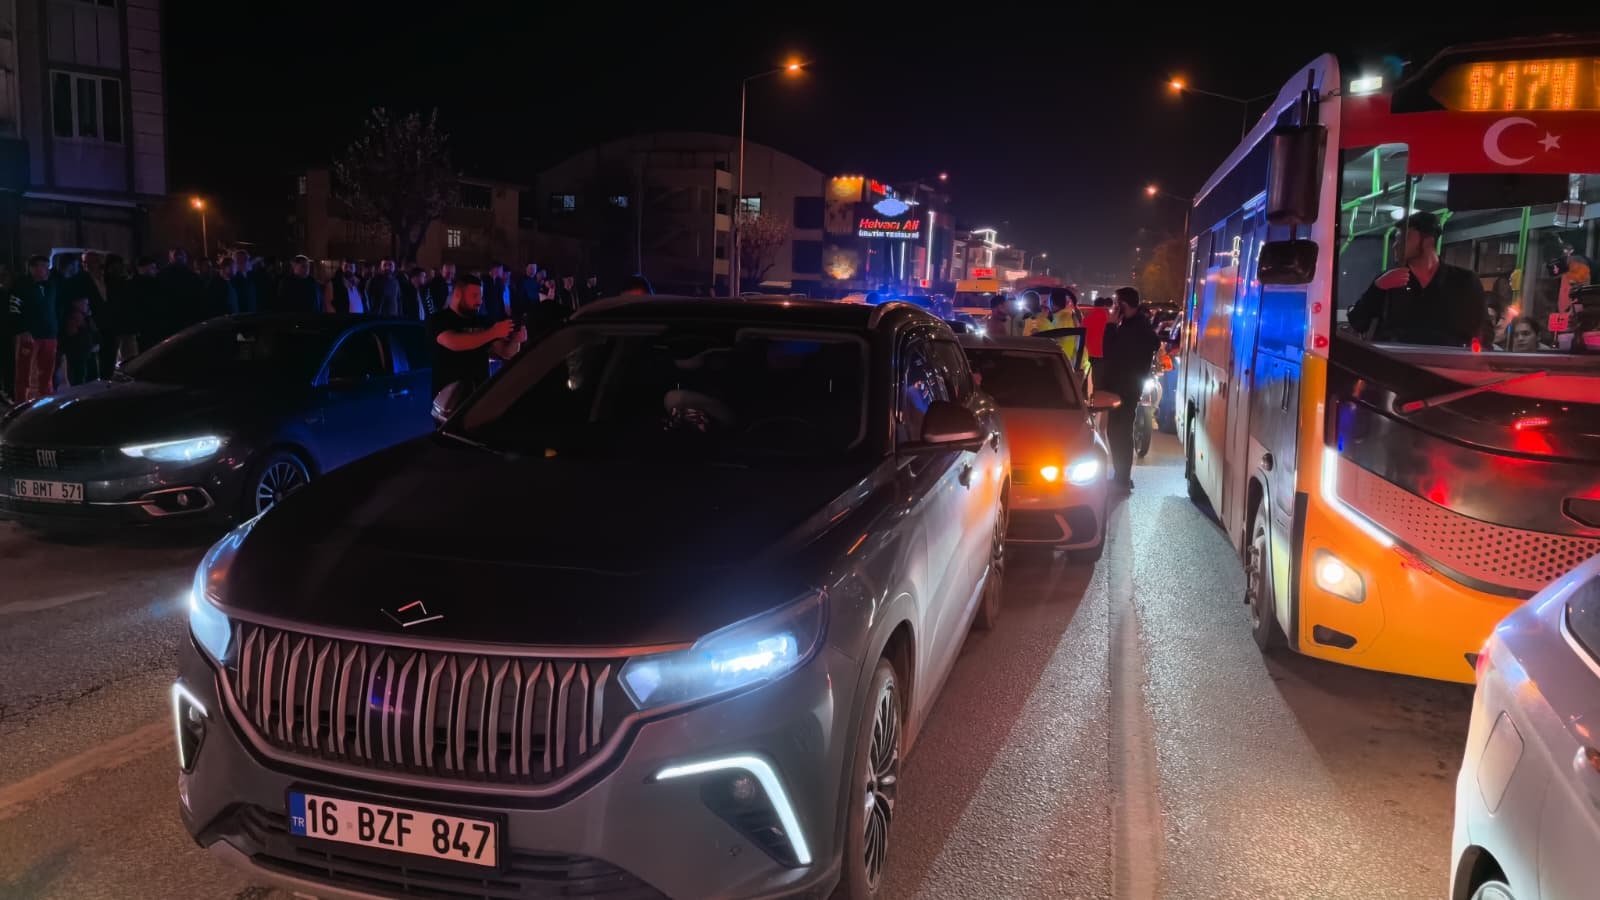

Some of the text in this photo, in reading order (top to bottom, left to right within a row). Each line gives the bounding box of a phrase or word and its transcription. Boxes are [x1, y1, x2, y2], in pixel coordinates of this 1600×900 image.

[903, 219, 920, 230] Ali
[36, 449, 58, 468] FIAT
[16, 480, 82, 499] 16 BMT 571
[292, 815, 305, 827] TR
[307, 798, 490, 860] 16 BZF 847
